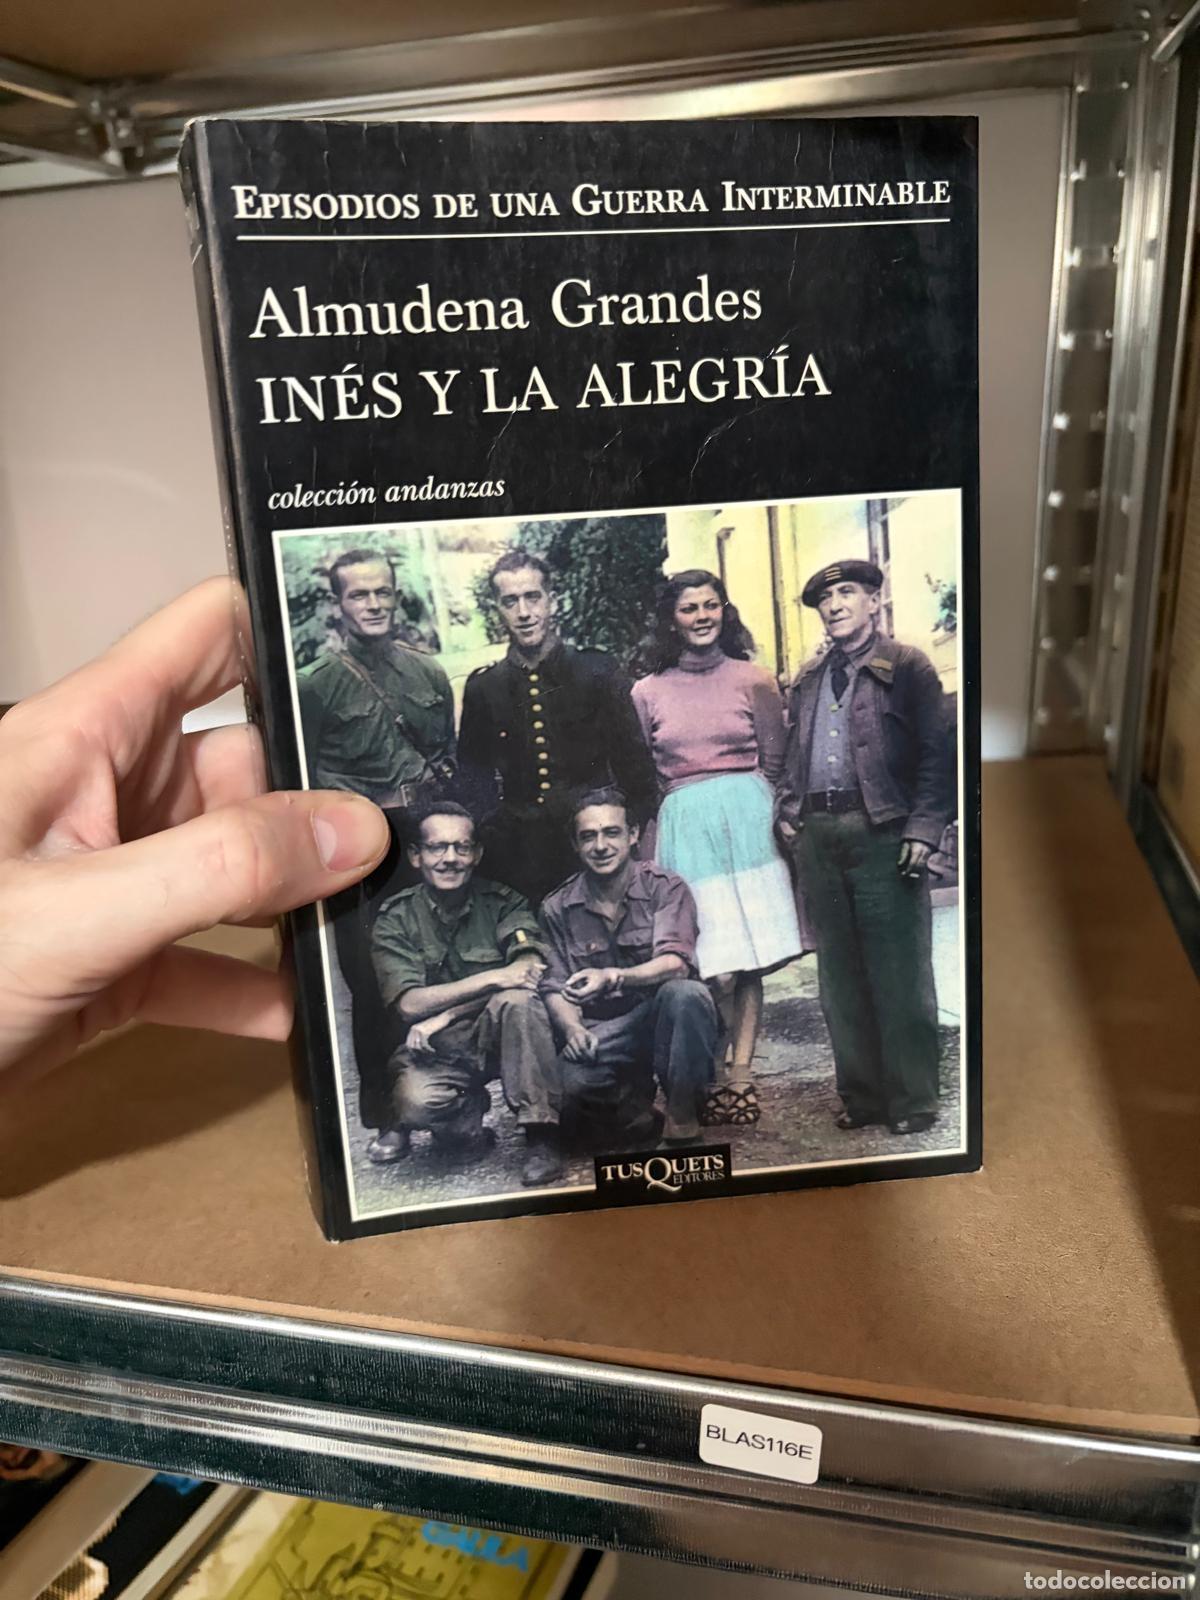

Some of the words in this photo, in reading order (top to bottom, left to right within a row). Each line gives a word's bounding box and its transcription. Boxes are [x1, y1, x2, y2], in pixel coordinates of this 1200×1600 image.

[231, 185, 420, 220] EPISODIOS
[433, 193, 479, 219] DE
[490, 193, 560, 218] UNA
[572, 183, 709, 216] GUERRA
[720, 180, 951, 209] INTERMINABLE
[248, 283, 530, 339] Almudena
[551, 274, 762, 328] Grandes
[257, 364, 402, 425] INÉS
[419, 370, 460, 416] Y
[480, 366, 559, 413] LA
[576, 345, 832, 409] ALEGRÍA
[268, 481, 376, 510] colección
[385, 475, 506, 503] andanzas
[601, 1154, 724, 1192] TUSQUETS
[673, 1172, 725, 1184] EDITORES
[706, 1424, 814, 1460] BLAS116E
